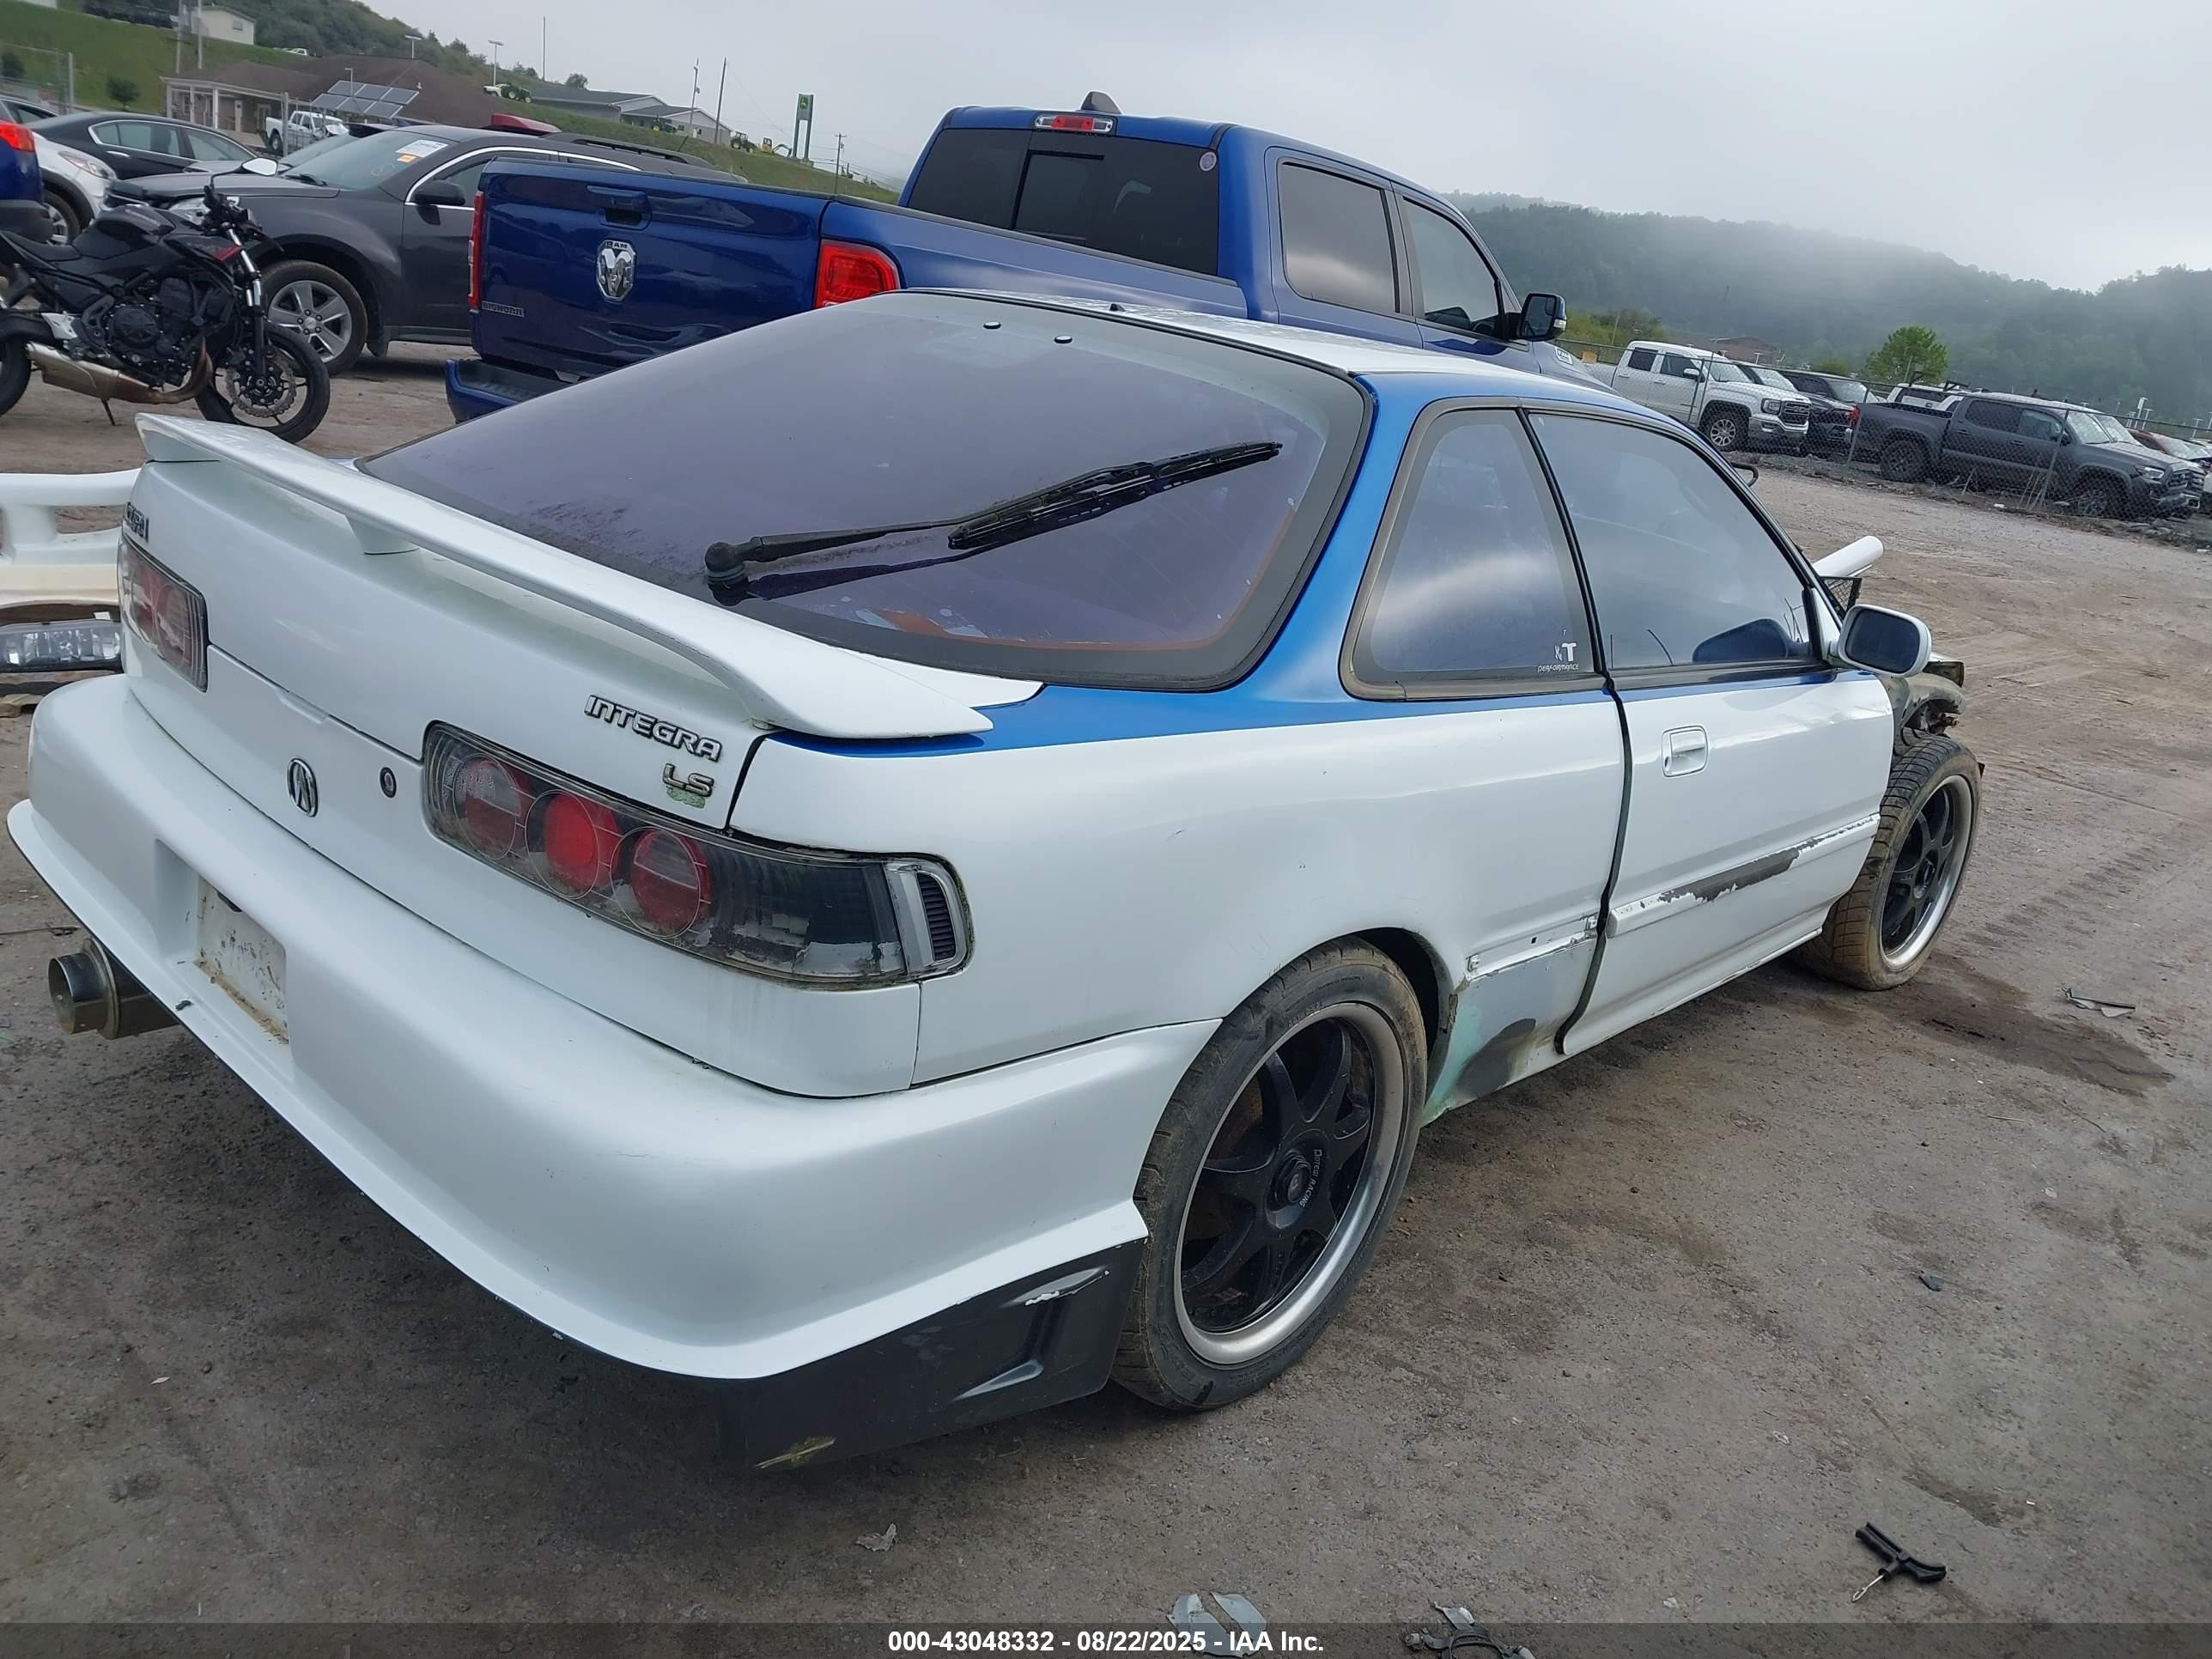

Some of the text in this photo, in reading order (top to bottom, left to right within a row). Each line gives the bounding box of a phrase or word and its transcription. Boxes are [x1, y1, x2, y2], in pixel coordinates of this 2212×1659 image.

[605, 240, 628, 249] RAM
[584, 695, 722, 763] INTEGRA
[662, 763, 714, 797] LS
[1299, 1177, 1316, 1208] RACING
